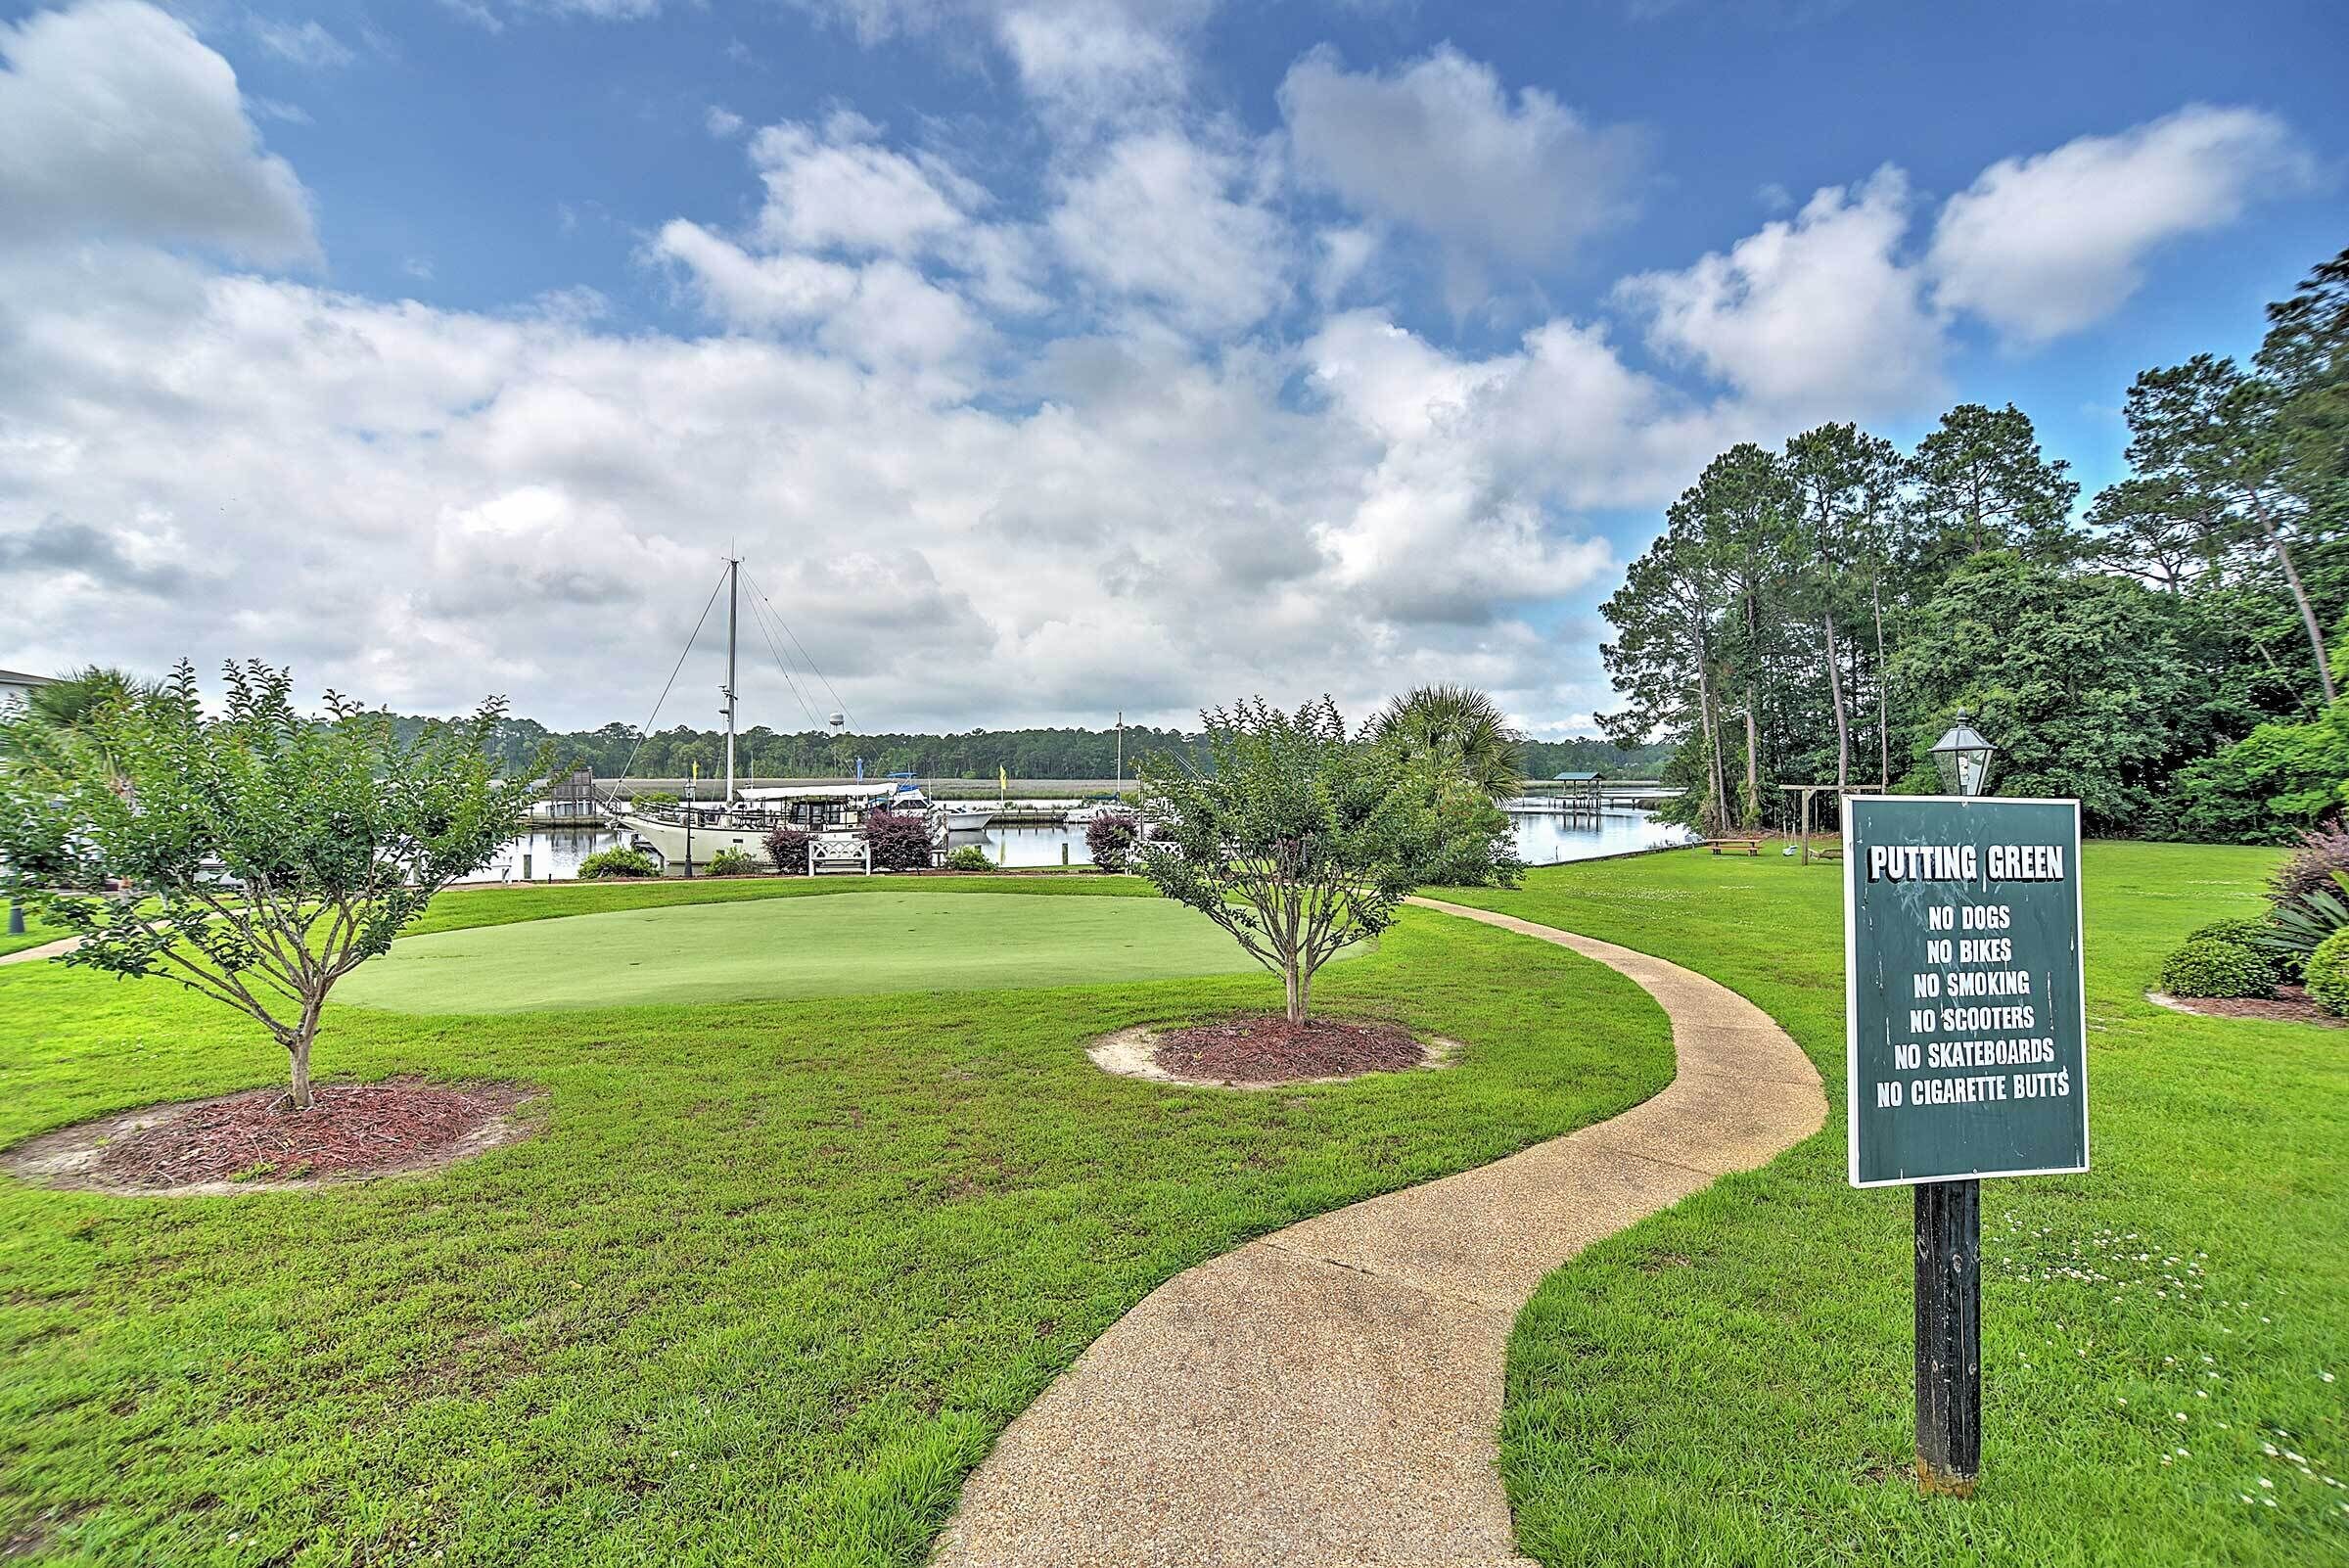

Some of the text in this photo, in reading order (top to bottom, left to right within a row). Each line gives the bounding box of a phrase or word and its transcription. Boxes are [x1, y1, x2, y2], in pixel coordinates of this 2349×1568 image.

[1869, 845, 2064, 883] PUTTING GREEN
[1929, 905, 2010, 931] NO DOGS
[1927, 938, 2012, 964] NO BIKES
[1913, 971, 2030, 998] NO SMOKING
[1910, 1006, 2035, 1034] NO SCOOTERS
[1895, 1038, 2054, 1070] NO SKATEBOARDS
[1876, 1070, 2070, 1108] NO CIGARETTE BUTTS
